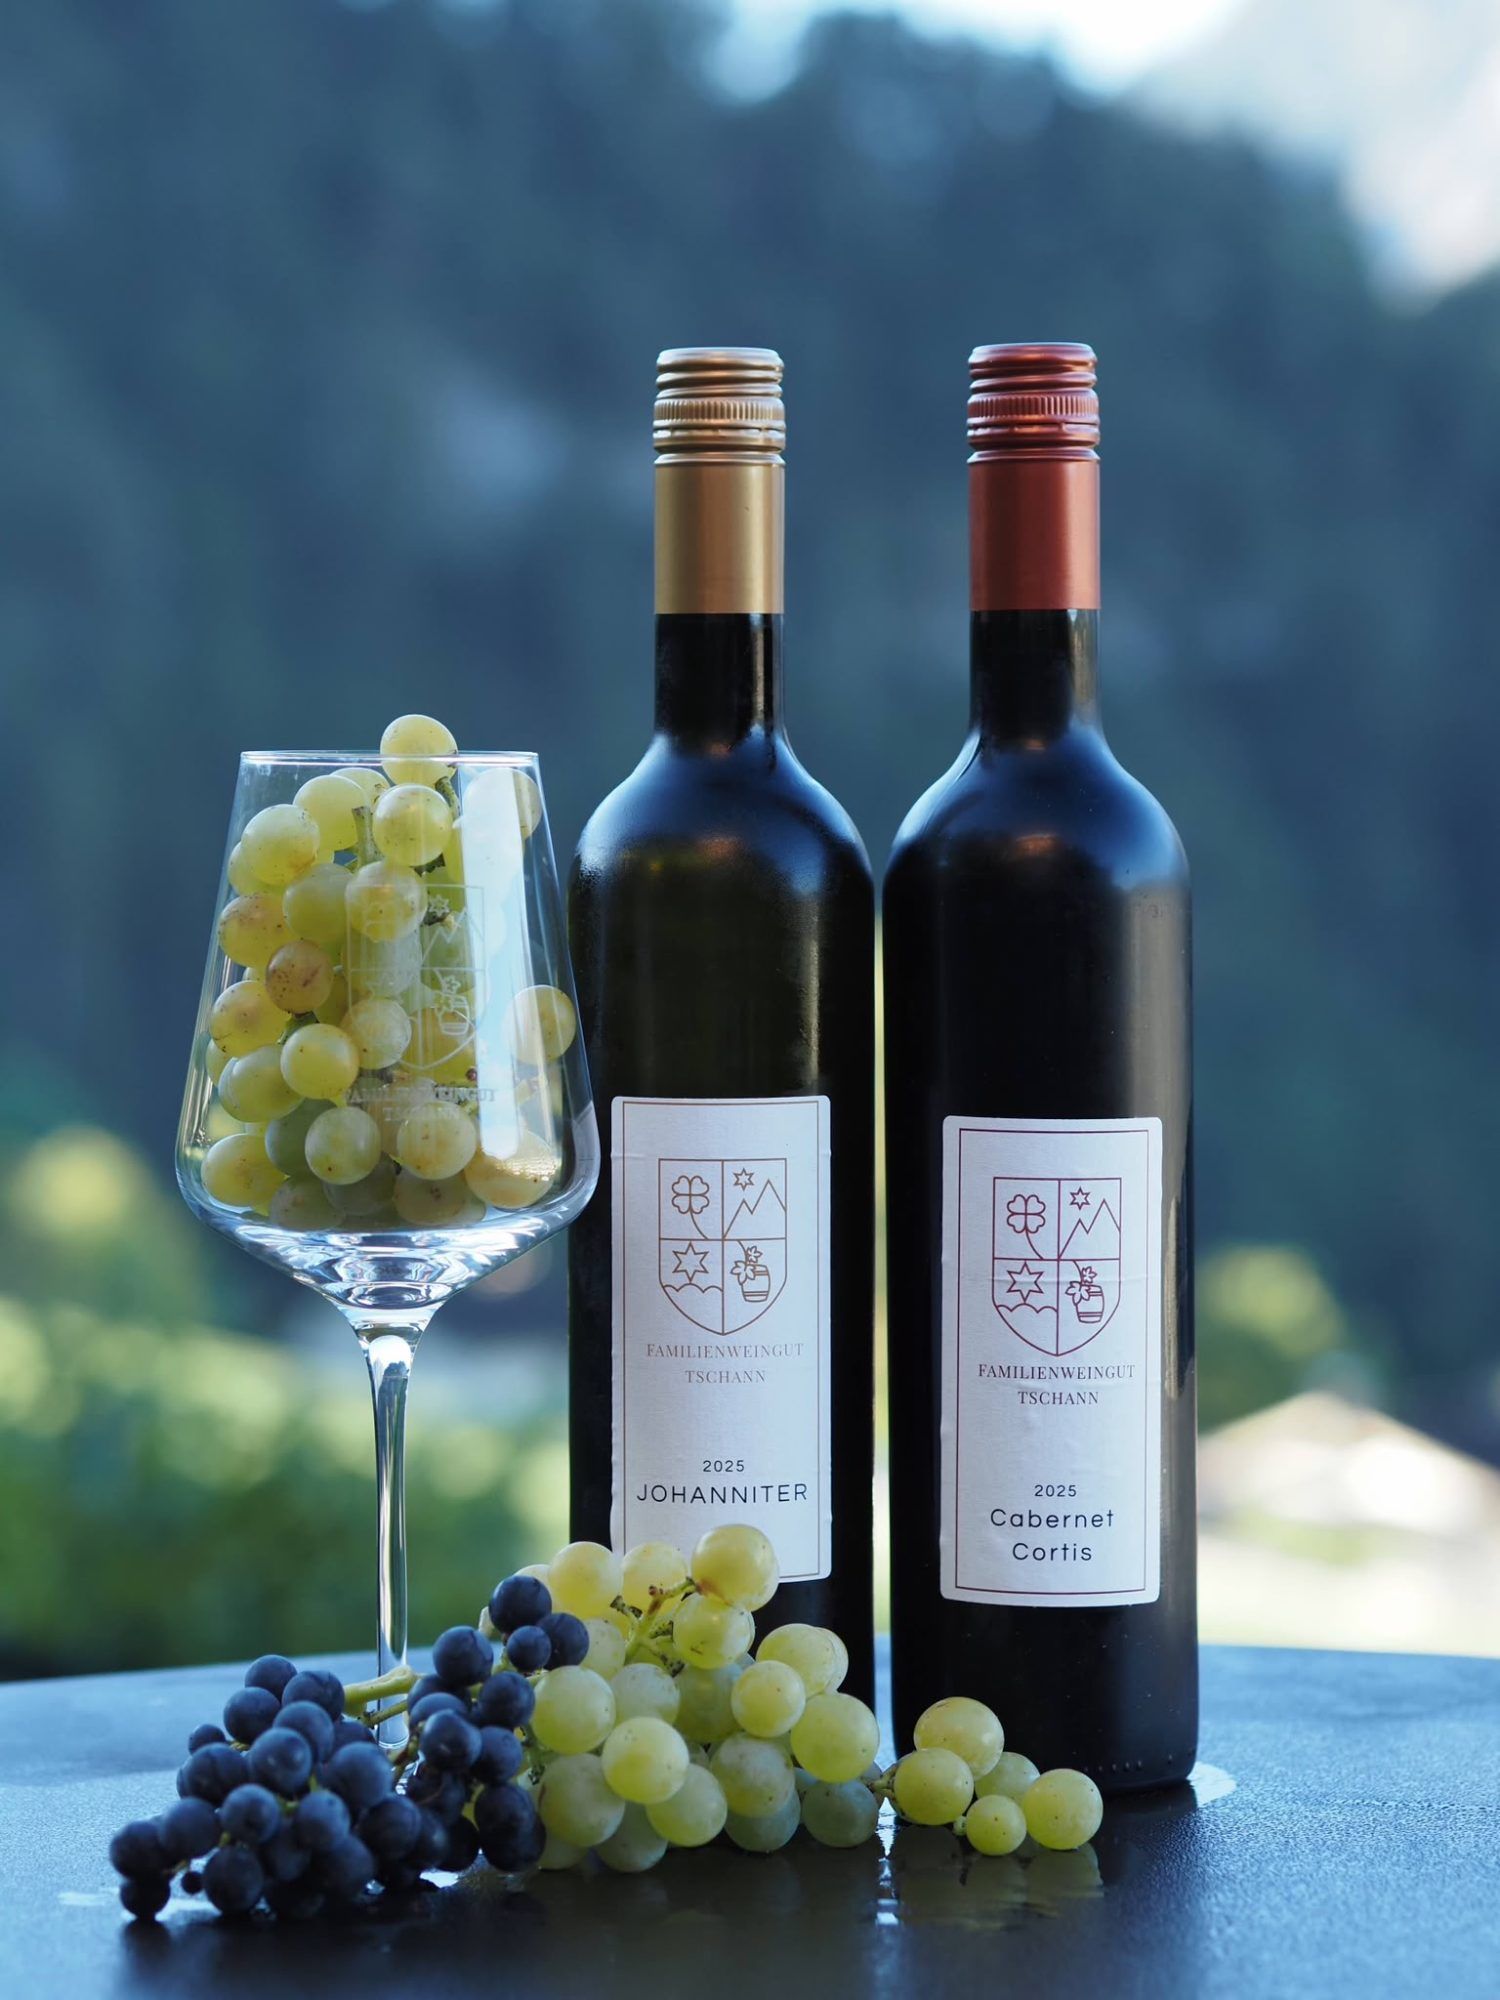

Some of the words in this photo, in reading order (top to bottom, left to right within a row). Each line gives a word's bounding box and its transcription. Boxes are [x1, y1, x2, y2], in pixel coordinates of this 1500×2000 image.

[646, 1343, 804, 1359] FAMILIENWEINGUT
[685, 1370, 767, 1384] TSCHANN
[978, 1363, 1136, 1380] FAMILIENWEINGUT
[1017, 1391, 1099, 1405] TSCHANN
[702, 1459, 745, 1472] 2025
[636, 1483, 808, 1504] JOHANNITER
[1034, 1484, 1077, 1497] 2025
[990, 1508, 1114, 1528] Cabernet
[1012, 1542, 1092, 1561] Cortis
